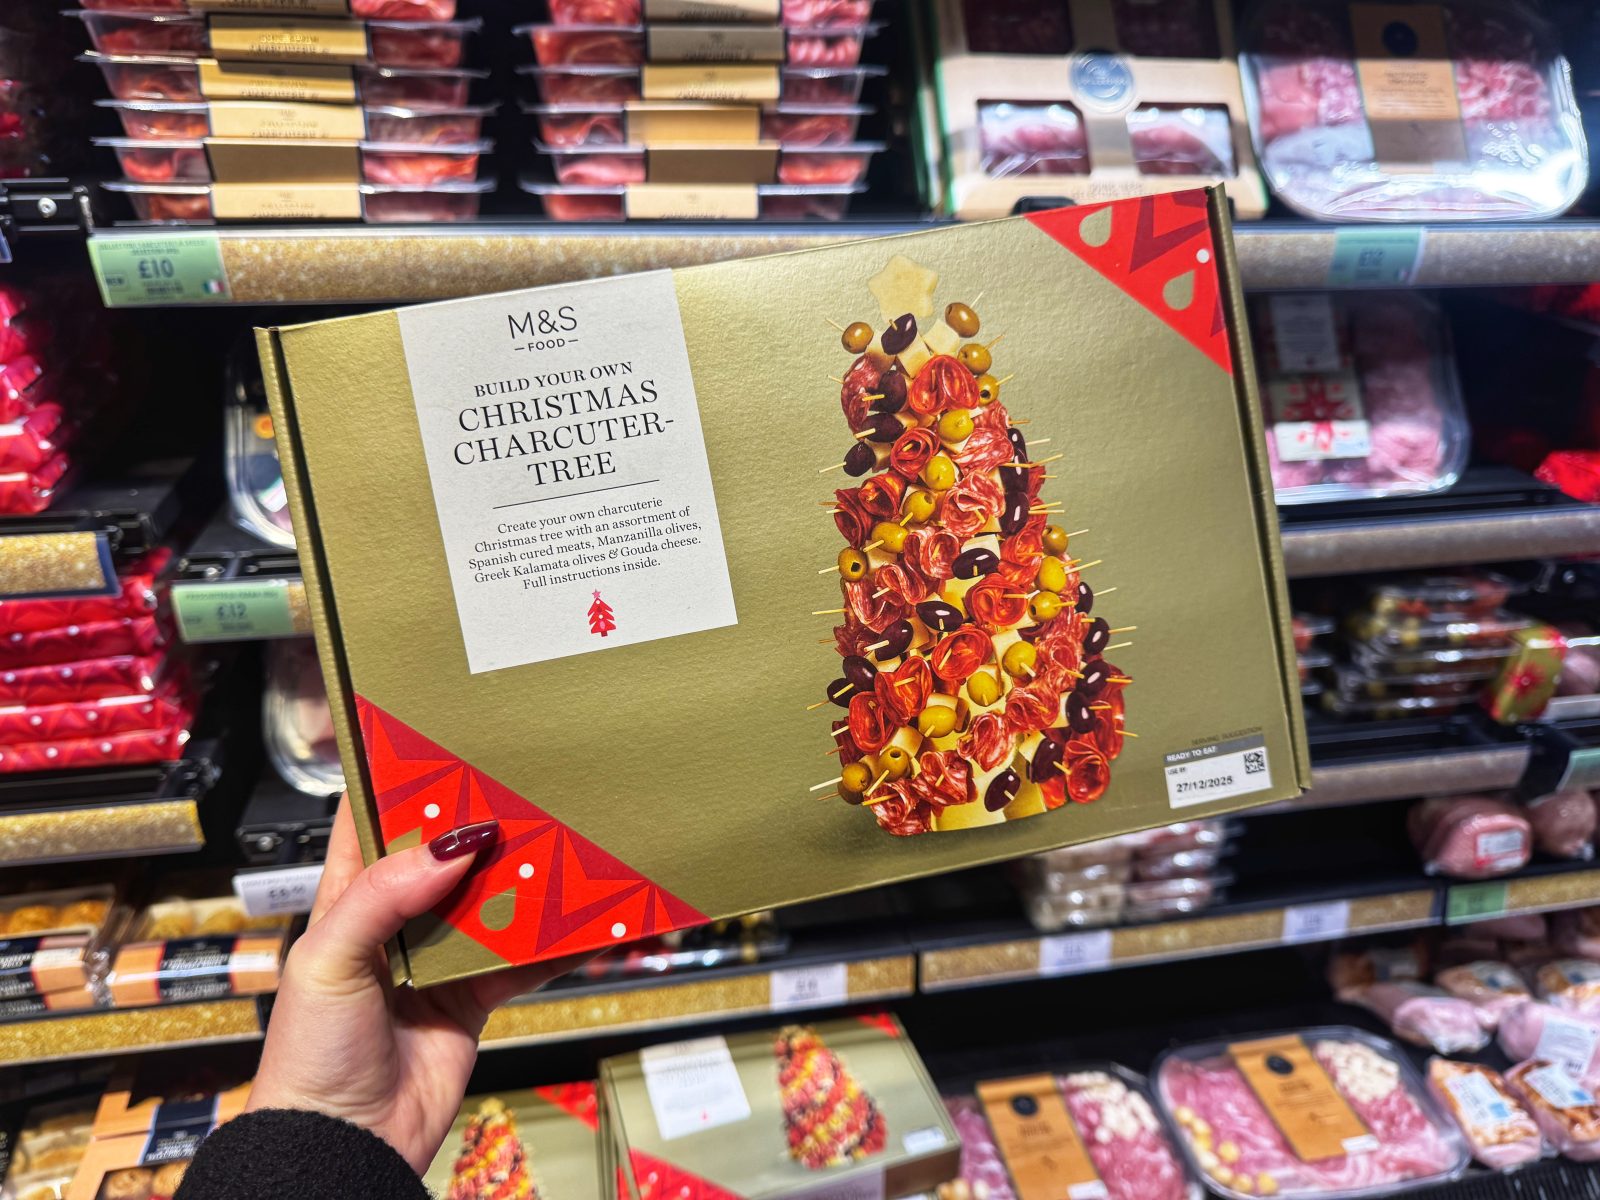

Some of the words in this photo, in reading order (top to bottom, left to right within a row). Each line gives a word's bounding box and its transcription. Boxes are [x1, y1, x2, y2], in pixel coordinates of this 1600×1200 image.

[138, 257, 174, 279] £10
[507, 305, 578, 339] M&S
[527, 338, 566, 352] FOOD
[474, 378, 531, 398] BUILD
[534, 369, 587, 388] YOUR
[590, 361, 633, 380] OWN
[458, 379, 659, 432] CHRISTMAS
[453, 411, 675, 466] CHARCUTER-
[526, 450, 617, 487] TREE
[474, 535, 537, 553] Christmas
[540, 530, 563, 542] tree
[565, 523, 593, 538] with
[595, 522, 610, 532] an
[612, 510, 676, 529] assortment
[678, 505, 690, 517] of
[497, 520, 537, 534] Create
[539, 515, 567, 530] your
[569, 510, 595, 522] own
[597, 497, 663, 517] charcuterie
[468, 551, 517, 571] Spanish
[519, 544, 554, 560] cured
[556, 540, 595, 554] meats,
[597, 526, 663, 547] Manzanilla
[665, 521, 702, 535] olives,
[474, 568, 511, 583] Greek
[513, 559, 570, 577] Kalamata
[572, 553, 606, 566] olives
[608, 548, 619, 559] &
[620, 541, 659, 557] Gouda
[660, 536, 702, 550] cheese.
[523, 575, 547, 590] Full
[549, 565, 621, 585] instructions
[622, 556, 661, 572] inside.
[1166, 751, 1190, 762] READY
[1191, 749, 1201, 757] TO
[1203, 745, 1218, 755] EAT
[1176, 775, 1234, 793] 27/12/2025
